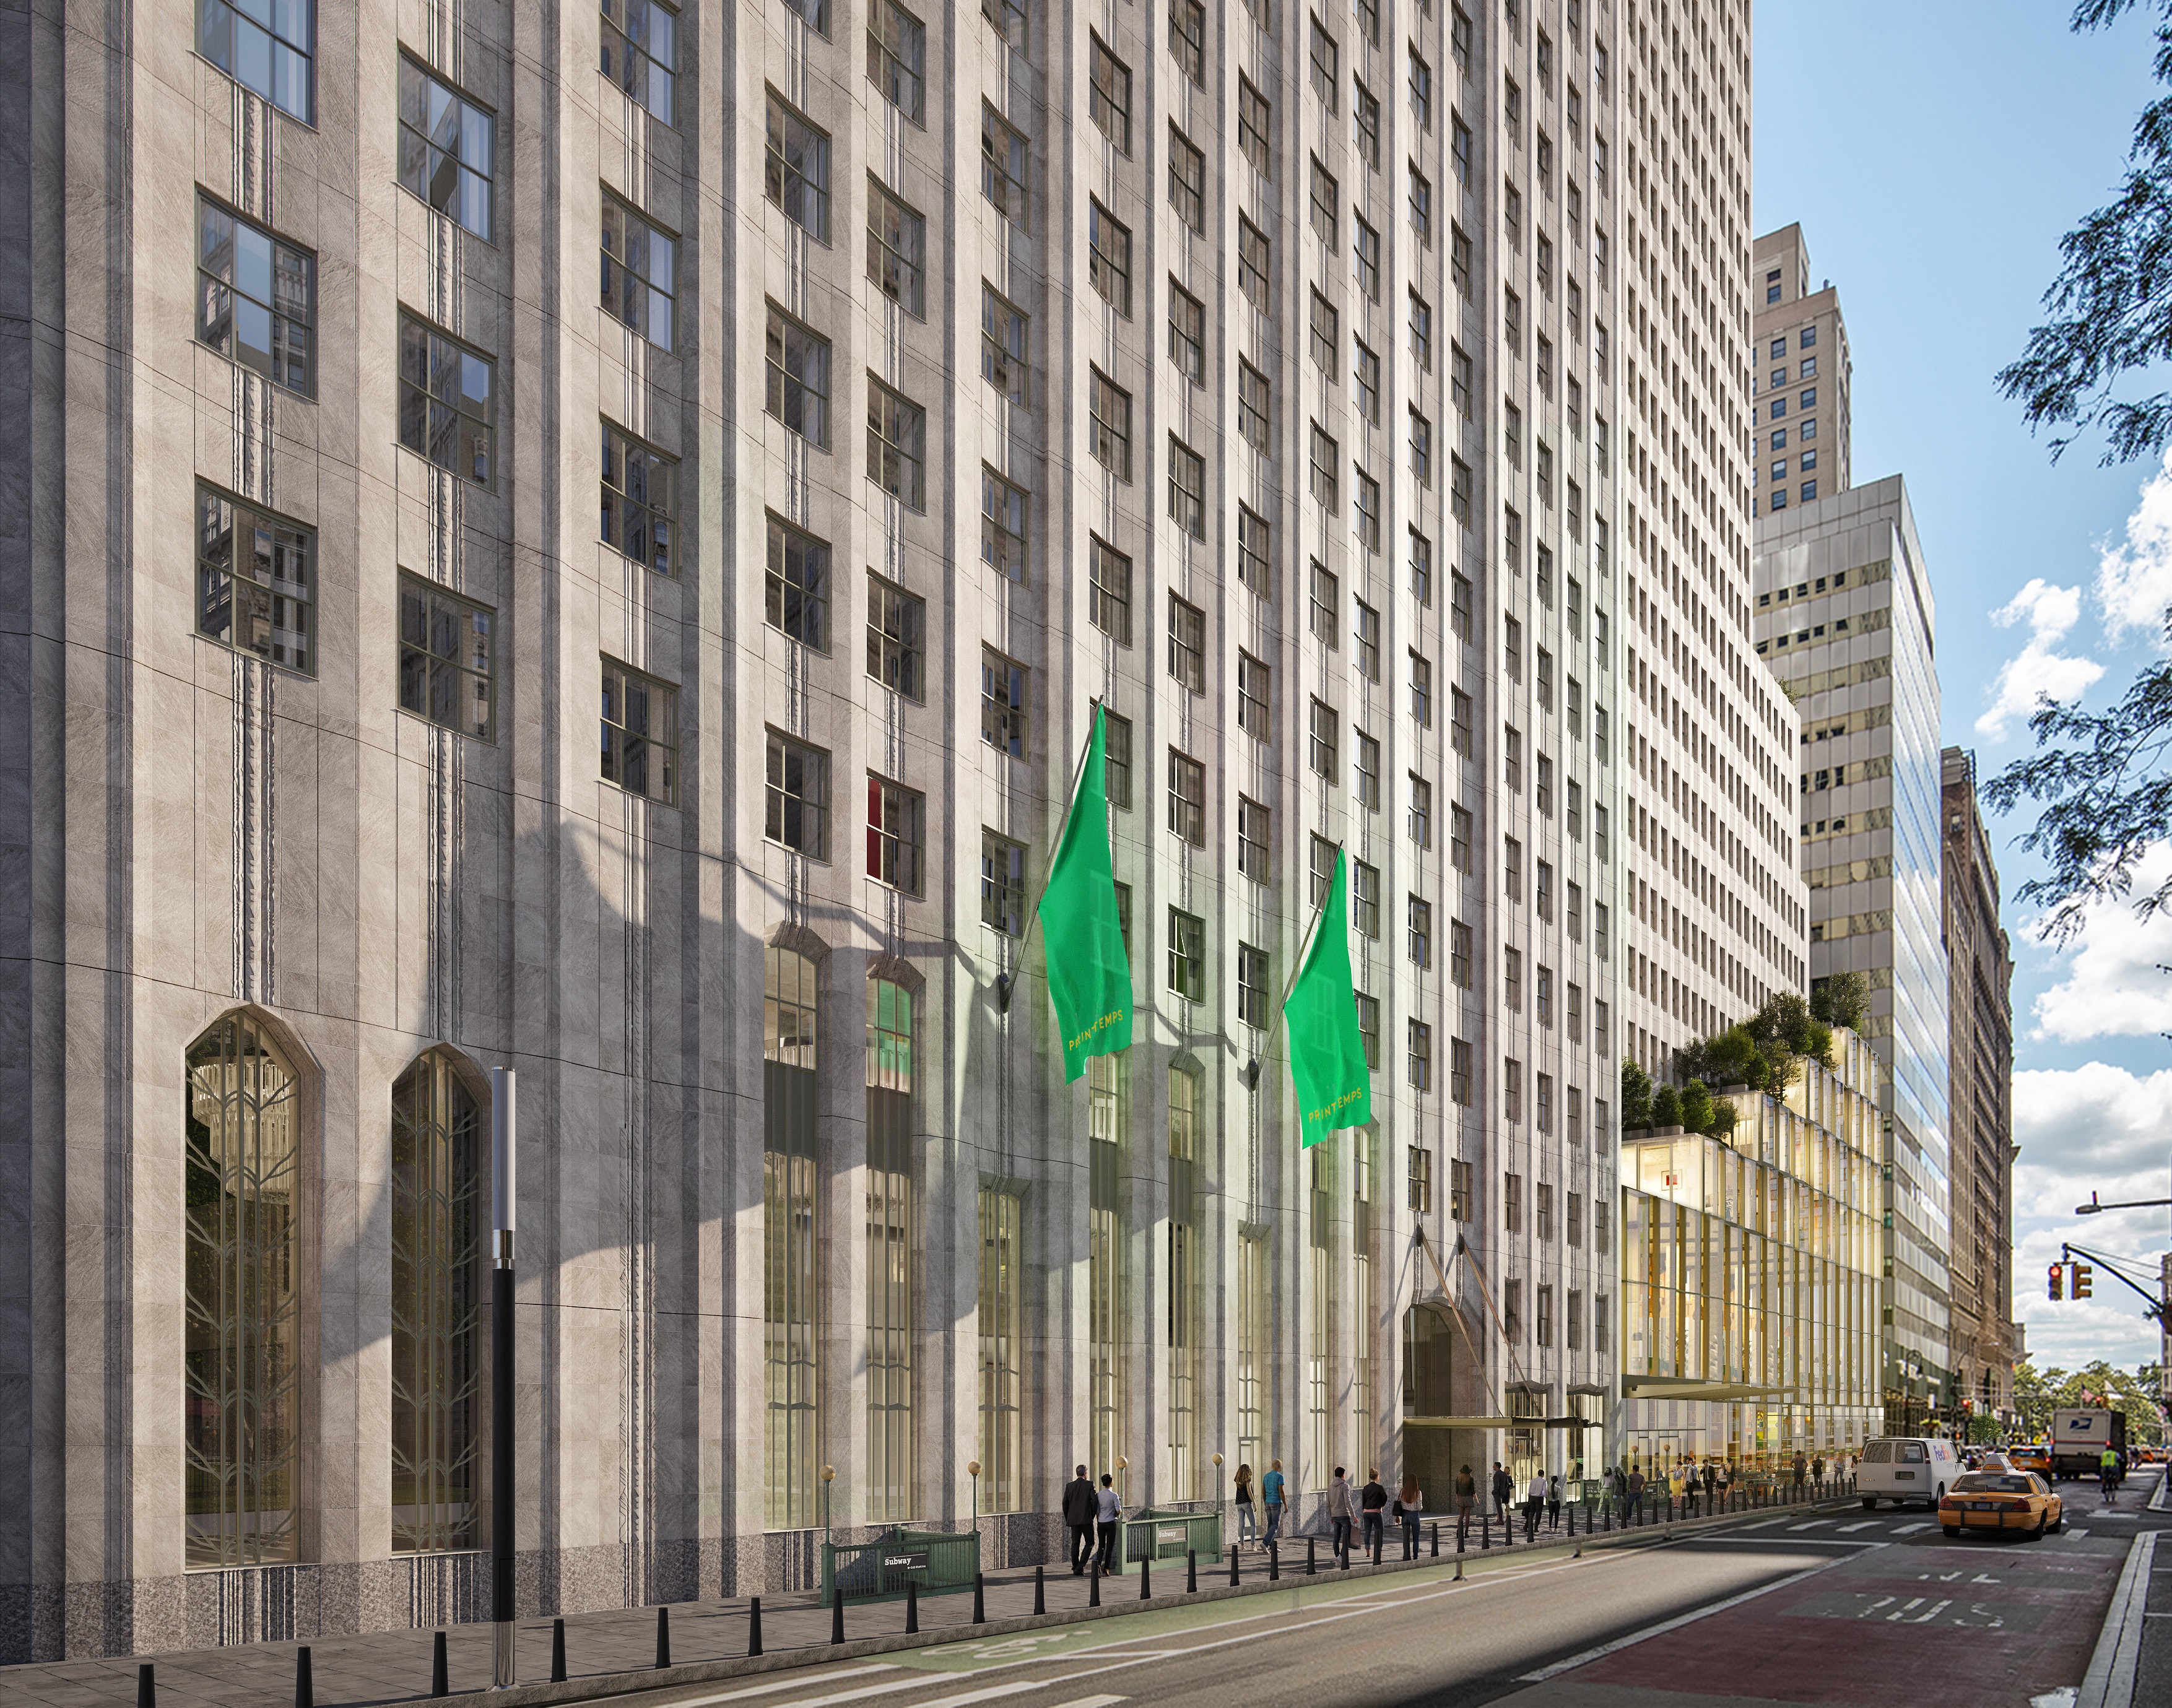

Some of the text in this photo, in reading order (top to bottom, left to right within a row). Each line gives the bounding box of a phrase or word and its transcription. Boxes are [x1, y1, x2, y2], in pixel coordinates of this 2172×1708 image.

[1069, 1010, 1123, 1051] PRINTEMPS
[1308, 1088, 1362, 1124] PRINTEMPS
[1933, 1444, 1951, 1461] FedEx
[885, 1558, 911, 1566] Subway
